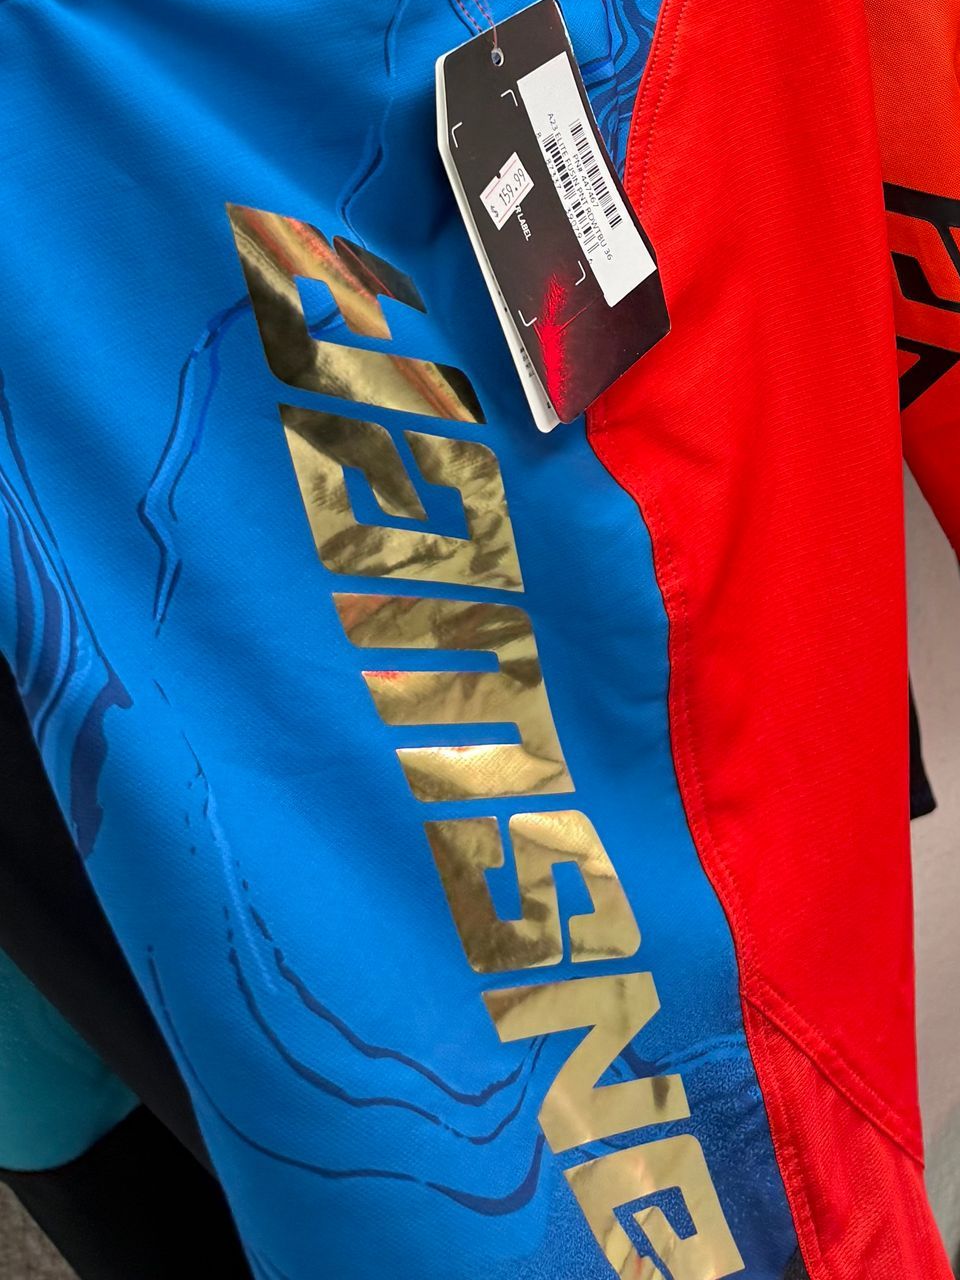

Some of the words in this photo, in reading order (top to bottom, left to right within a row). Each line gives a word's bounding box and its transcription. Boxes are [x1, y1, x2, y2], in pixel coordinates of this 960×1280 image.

[498, 168, 527, 207] 159.99
[547, 113, 557, 131] A23
[555, 132, 569, 158] ELITE
[565, 158, 579, 189] FUSIN
[577, 187, 588, 207] PNT
[603, 248, 614, 261] 36
[580, 174, 599, 207] 447467
[517, 213, 533, 241] LABEL
[226, 202, 744, 1280] ANSWER
